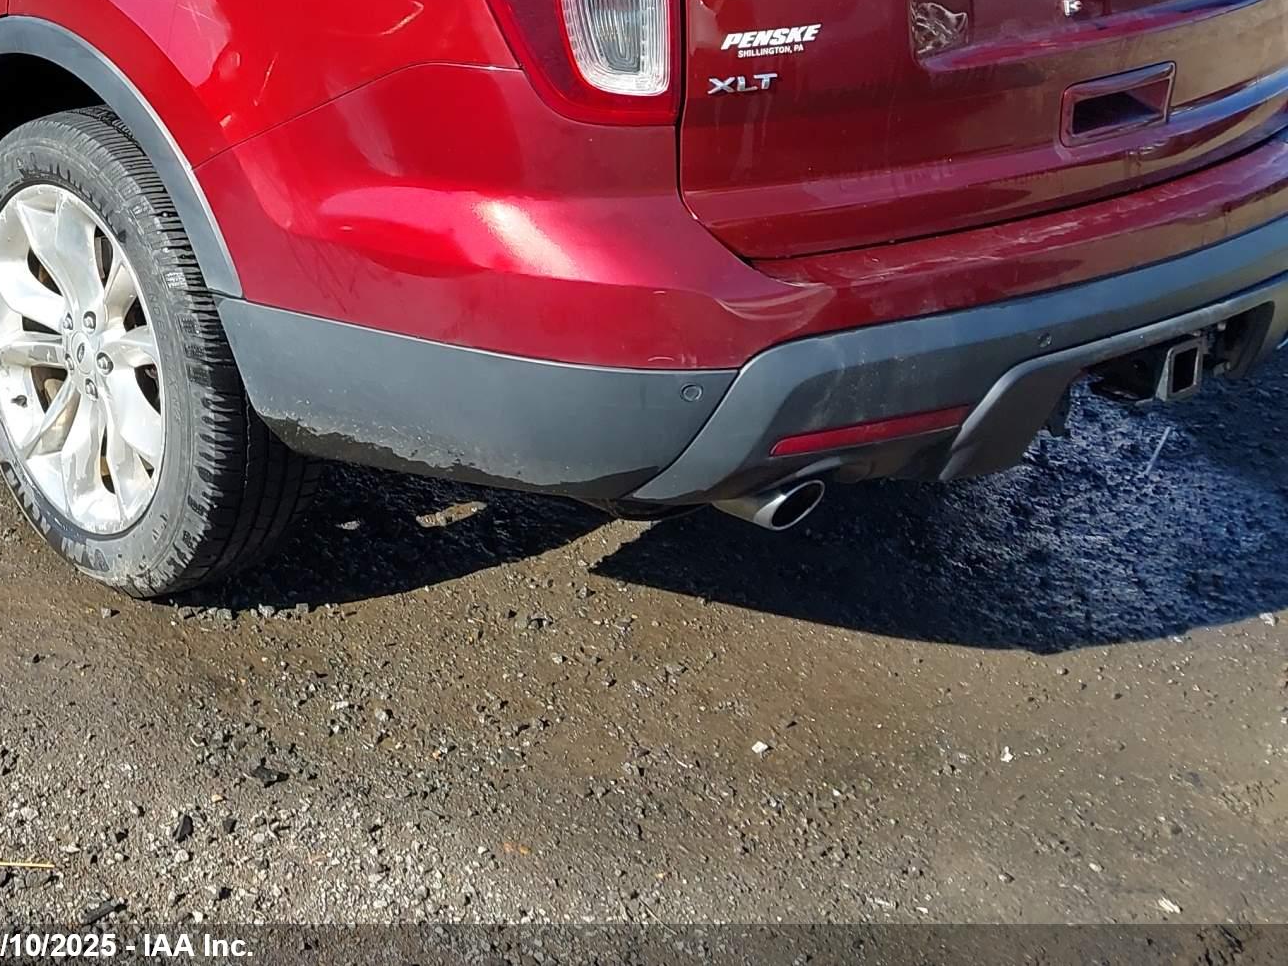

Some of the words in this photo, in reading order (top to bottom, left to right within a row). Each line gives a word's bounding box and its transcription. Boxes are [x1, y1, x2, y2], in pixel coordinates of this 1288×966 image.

[720, 23, 822, 51] PENSKE
[737, 46, 793, 59] SHILLINGTON,
[793, 44, 804, 52] PA
[707, 73, 778, 95] XLT
